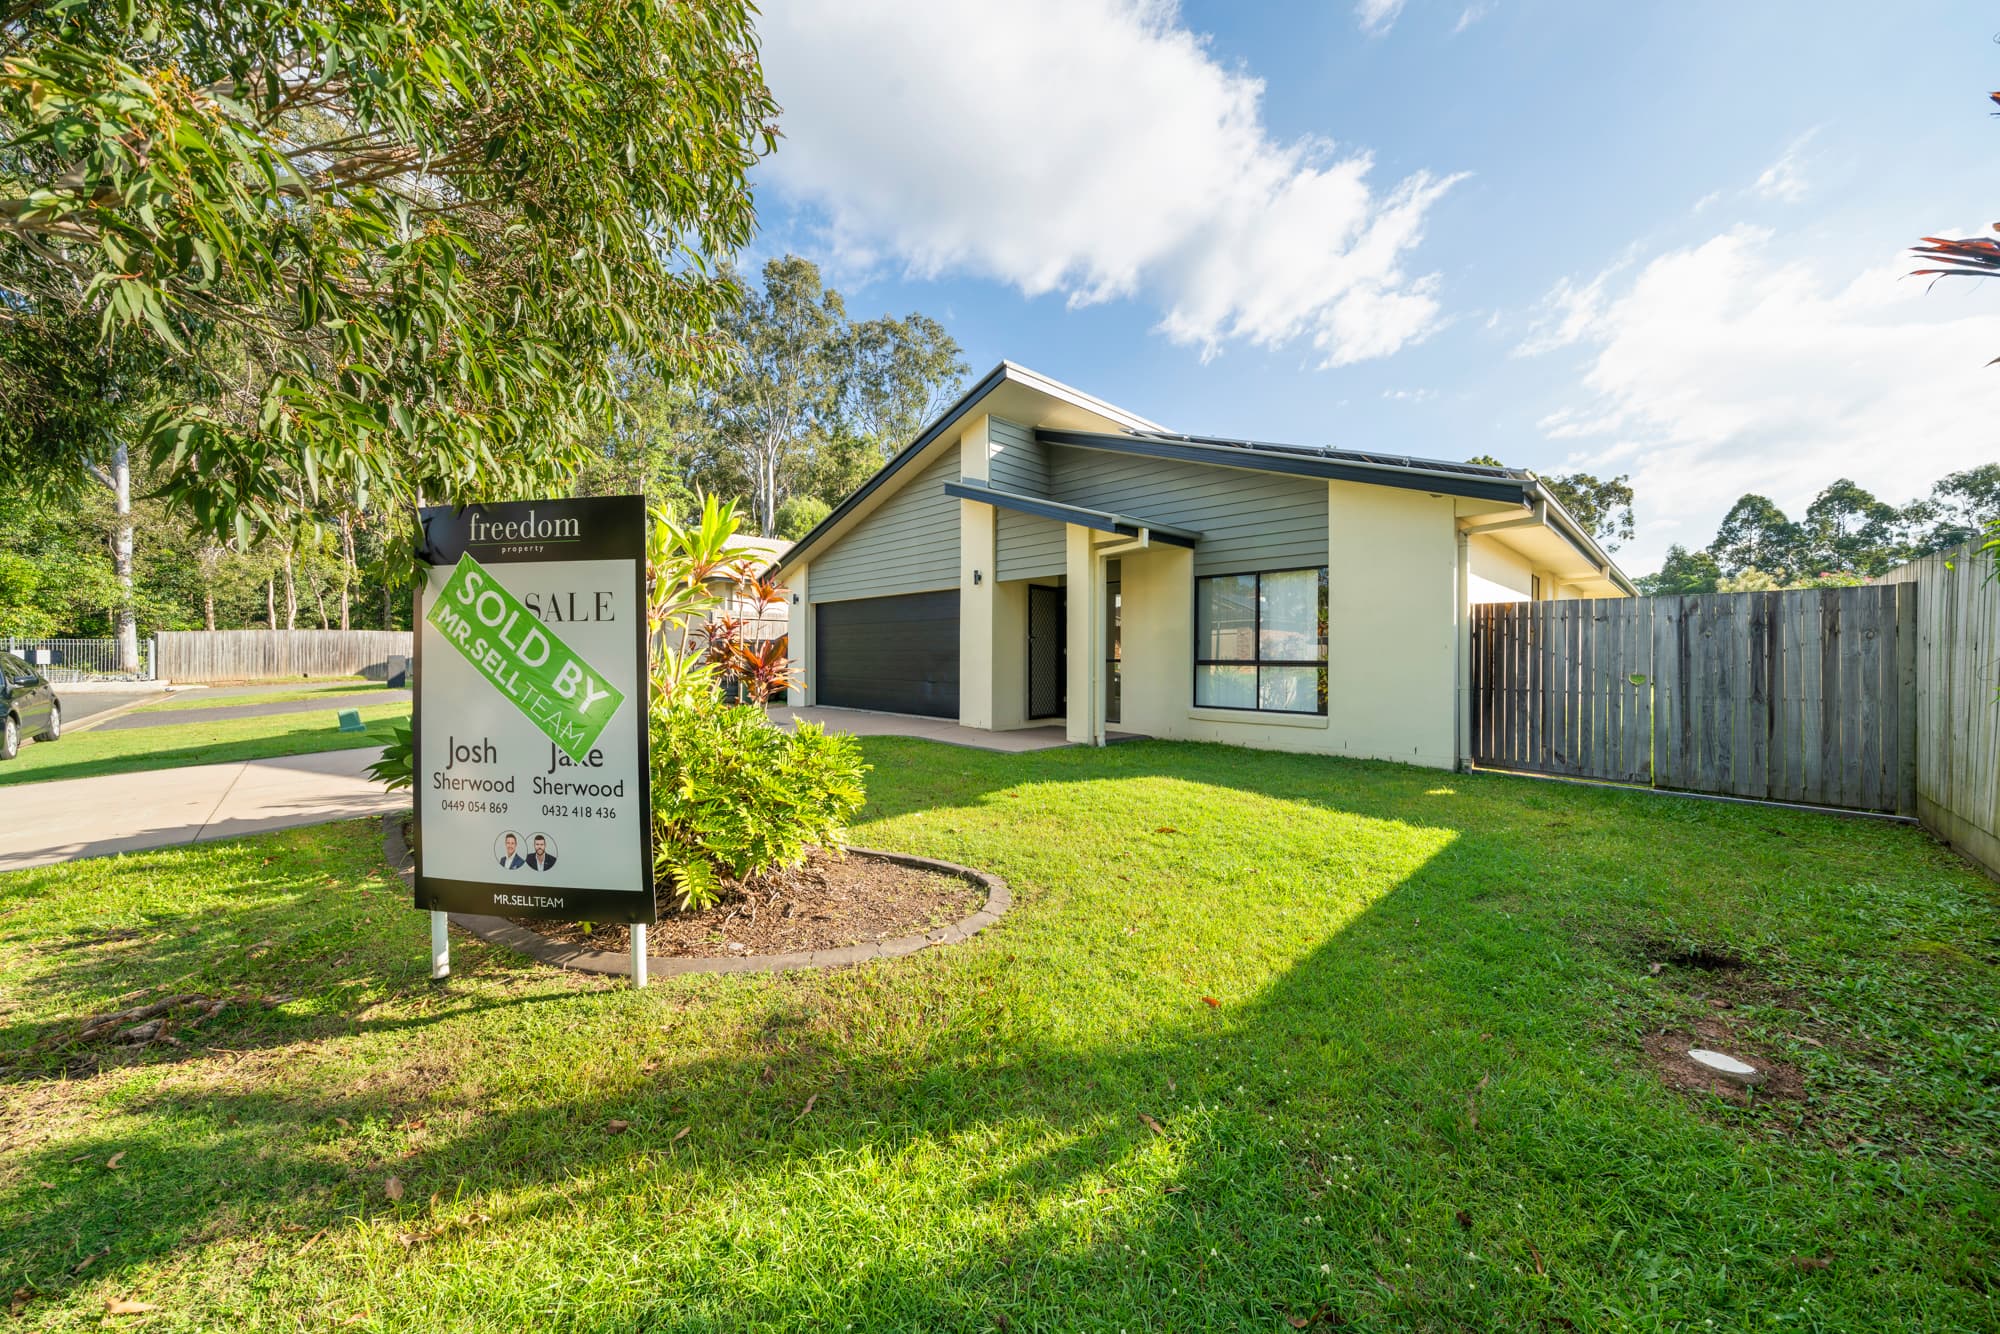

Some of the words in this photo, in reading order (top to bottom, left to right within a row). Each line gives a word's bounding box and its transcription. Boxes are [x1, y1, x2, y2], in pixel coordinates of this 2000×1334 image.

[469, 510, 581, 542] freedom
[501, 544, 544, 554] property
[524, 591, 616, 622] SALE
[456, 571, 550, 668] SOLD
[551, 659, 610, 715] BY
[446, 736, 497, 770] Josh
[547, 741, 604, 775] Jae
[433, 772, 515, 793] Sherwood
[533, 776, 624, 797] Sherwood
[441, 799, 465, 812] 0449
[468, 801, 486, 813] 054
[489, 802, 508, 814] 869
[542, 804, 568, 817] 0432
[571, 805, 592, 818] 418
[595, 807, 616, 819] 436
